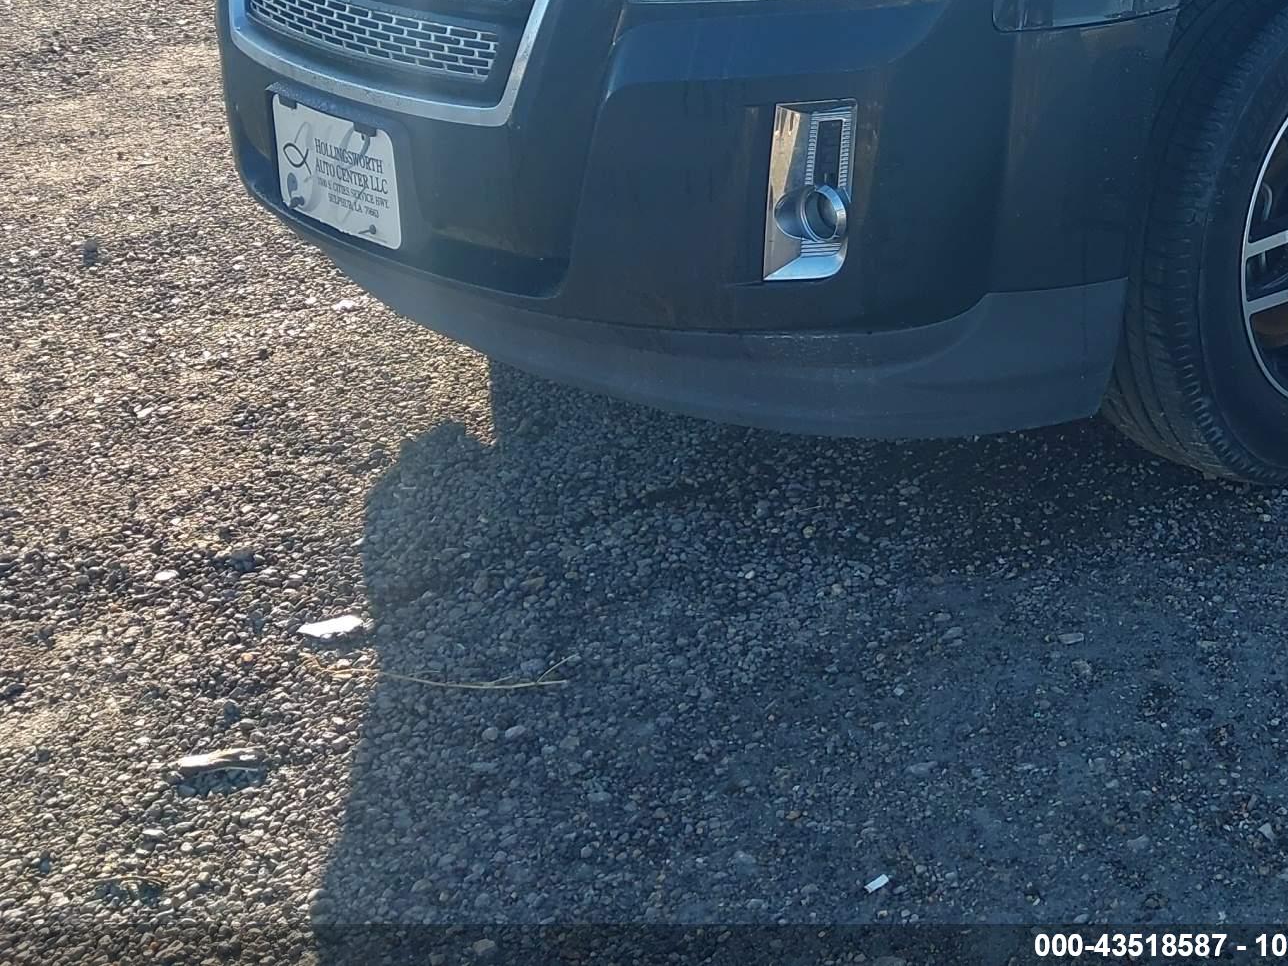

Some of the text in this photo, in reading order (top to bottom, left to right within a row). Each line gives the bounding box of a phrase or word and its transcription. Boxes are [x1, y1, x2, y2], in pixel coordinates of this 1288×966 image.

[314, 137, 384, 175] HOLLINGSWORTH
[315, 157, 336, 178] AUTO
[336, 164, 370, 190] CENTER
[370, 175, 389, 195] LLC
